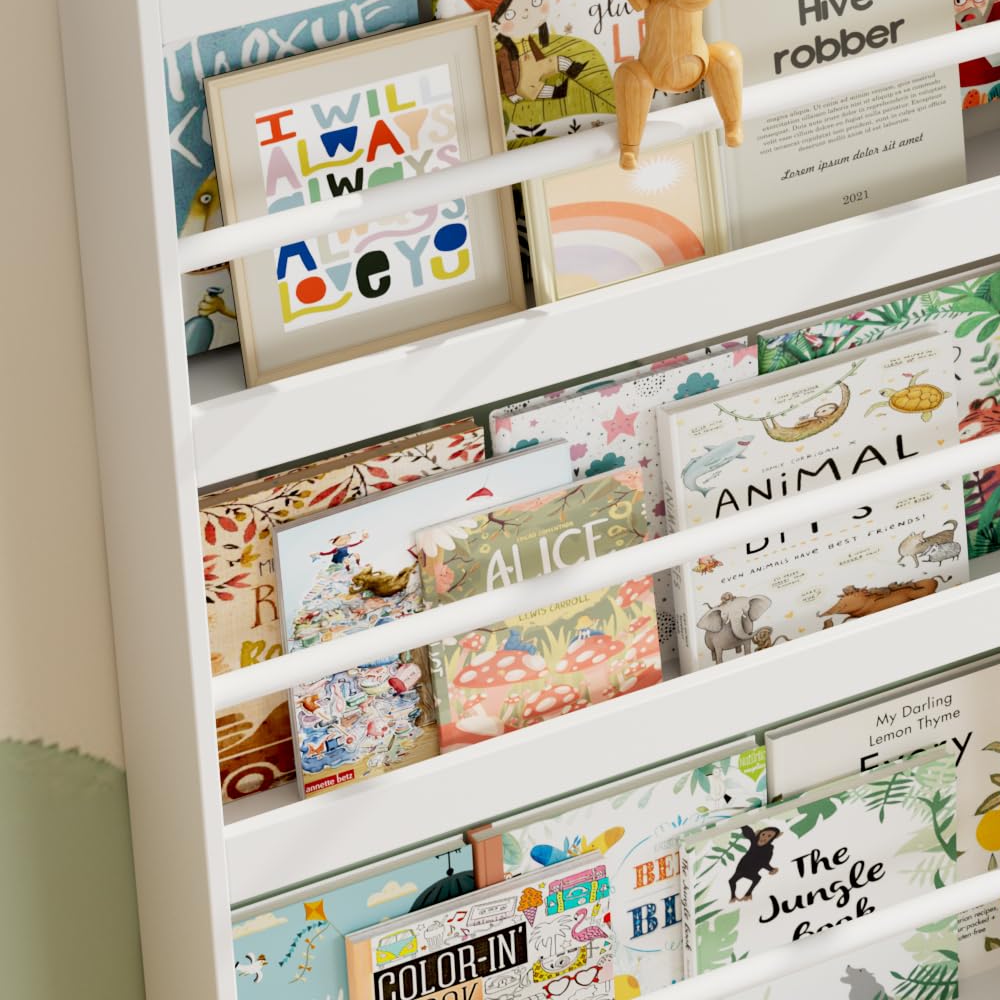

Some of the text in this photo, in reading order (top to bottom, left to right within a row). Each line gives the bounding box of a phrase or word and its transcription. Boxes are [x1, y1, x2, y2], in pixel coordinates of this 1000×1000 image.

[773, 18, 906, 75] robber
[256, 109, 297, 146] I
[311, 75, 453, 130] WILL
[265, 104, 458, 197] ALWAYS
[781, 133, 924, 180] Lorem ipsum dolor sit amet
[842, 189, 869, 205] 2021
[487, 518, 611, 592] ALICE
[518, 594, 591, 622] LEWIS CARROLL
[869, 709, 961, 747] Lemon Thyme
[876, 694, 952, 727] My Darling
[305, 771, 353, 793] annette betz
[791, 846, 850, 879] The
[758, 860, 886, 924] Jungle
